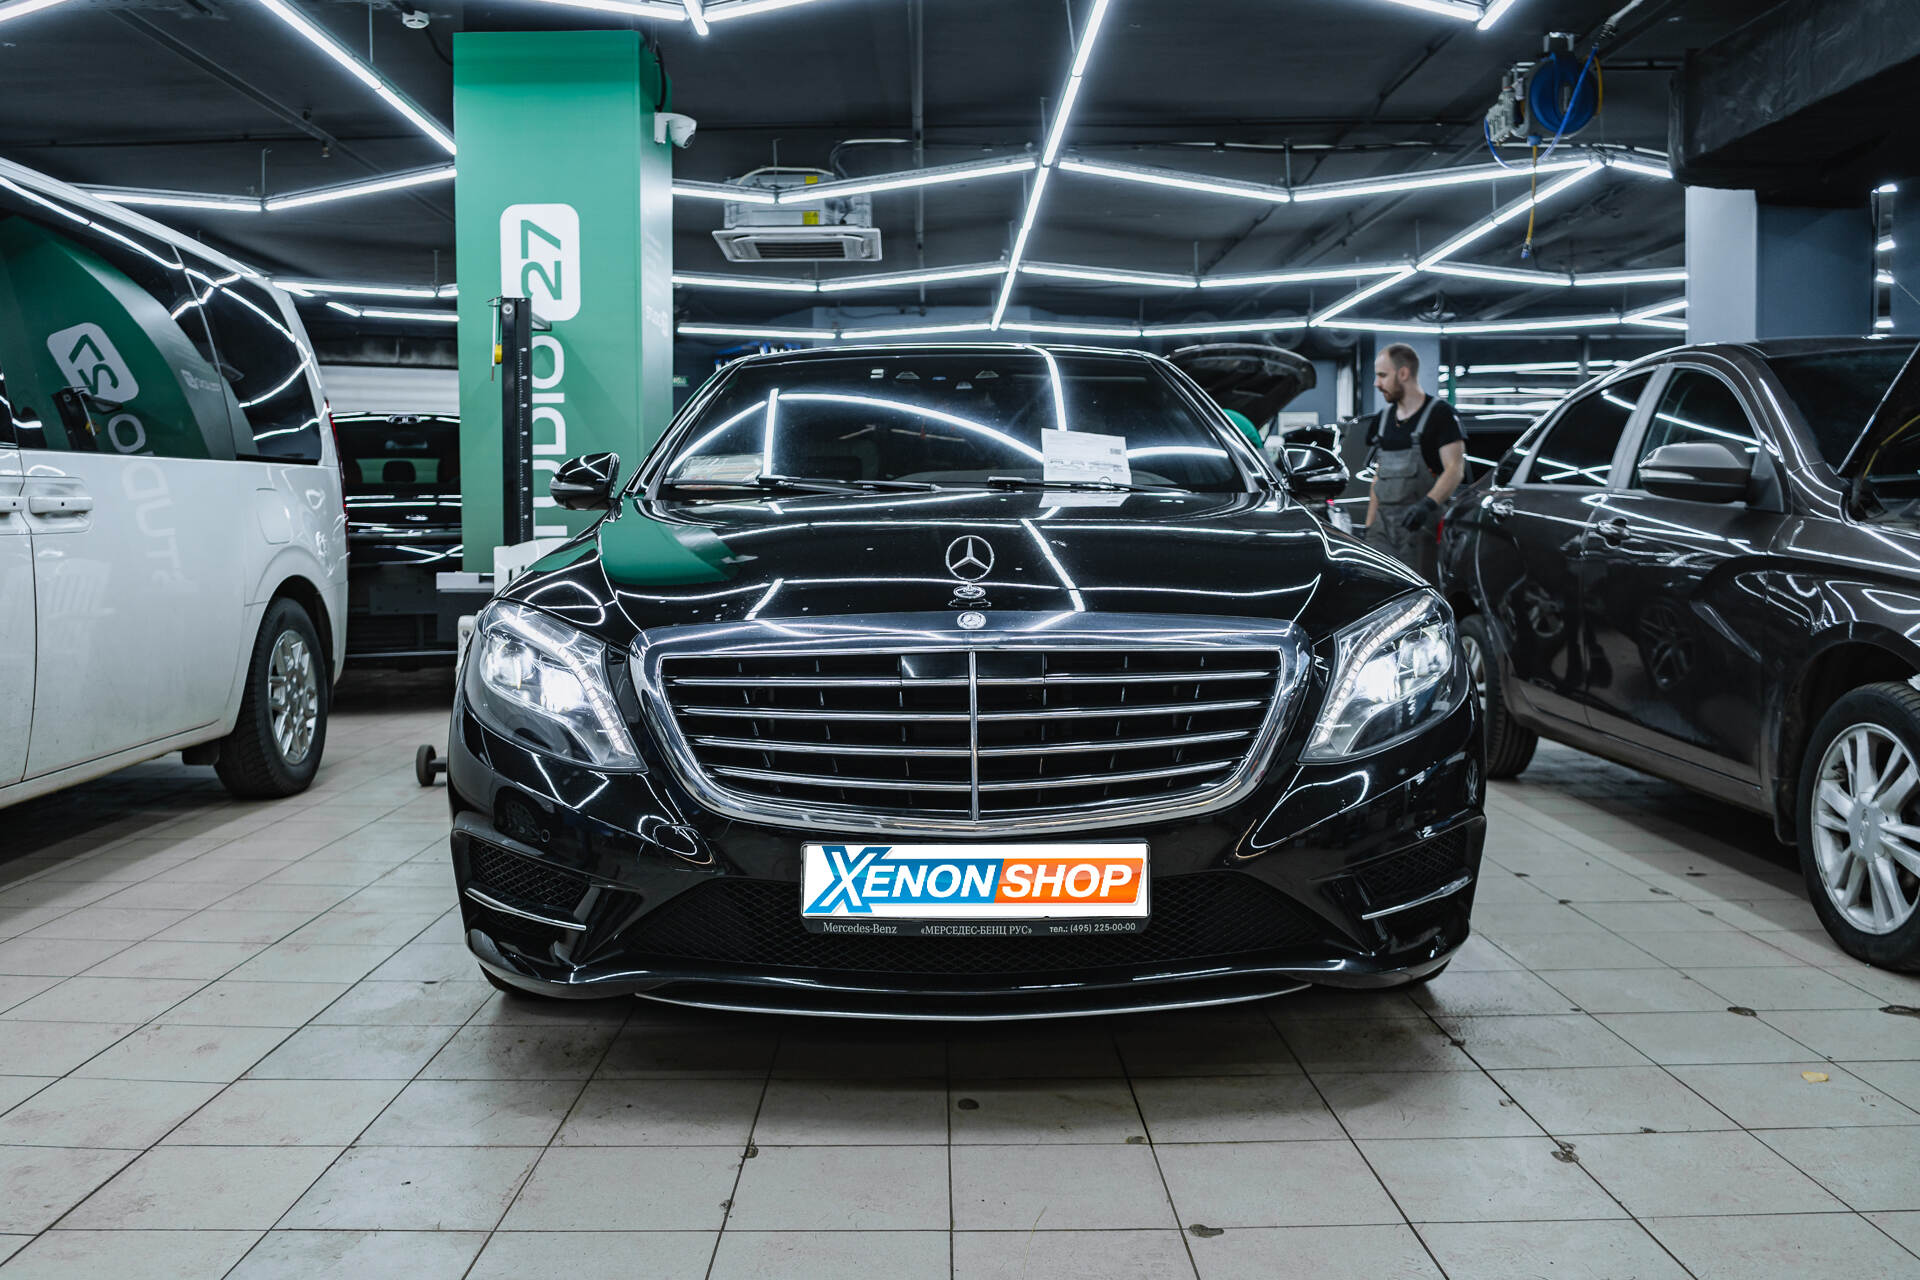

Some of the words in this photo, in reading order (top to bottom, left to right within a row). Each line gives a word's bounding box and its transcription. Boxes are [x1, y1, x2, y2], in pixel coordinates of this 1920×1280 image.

[520, 219, 562, 301] 27
[532, 335, 568, 536] TUDIO
[823, 921, 898, 935] Mercedes-Benz
[920, 925, 1007, 936] «МЕРСЕДЕС-БЕНЦ
[1009, 925, 1033, 936] РУС»
[1049, 925, 1068, 934] тел.:
[1070, 923, 1092, 934] (495)
[1094, 922, 1137, 933] 225-00-00
